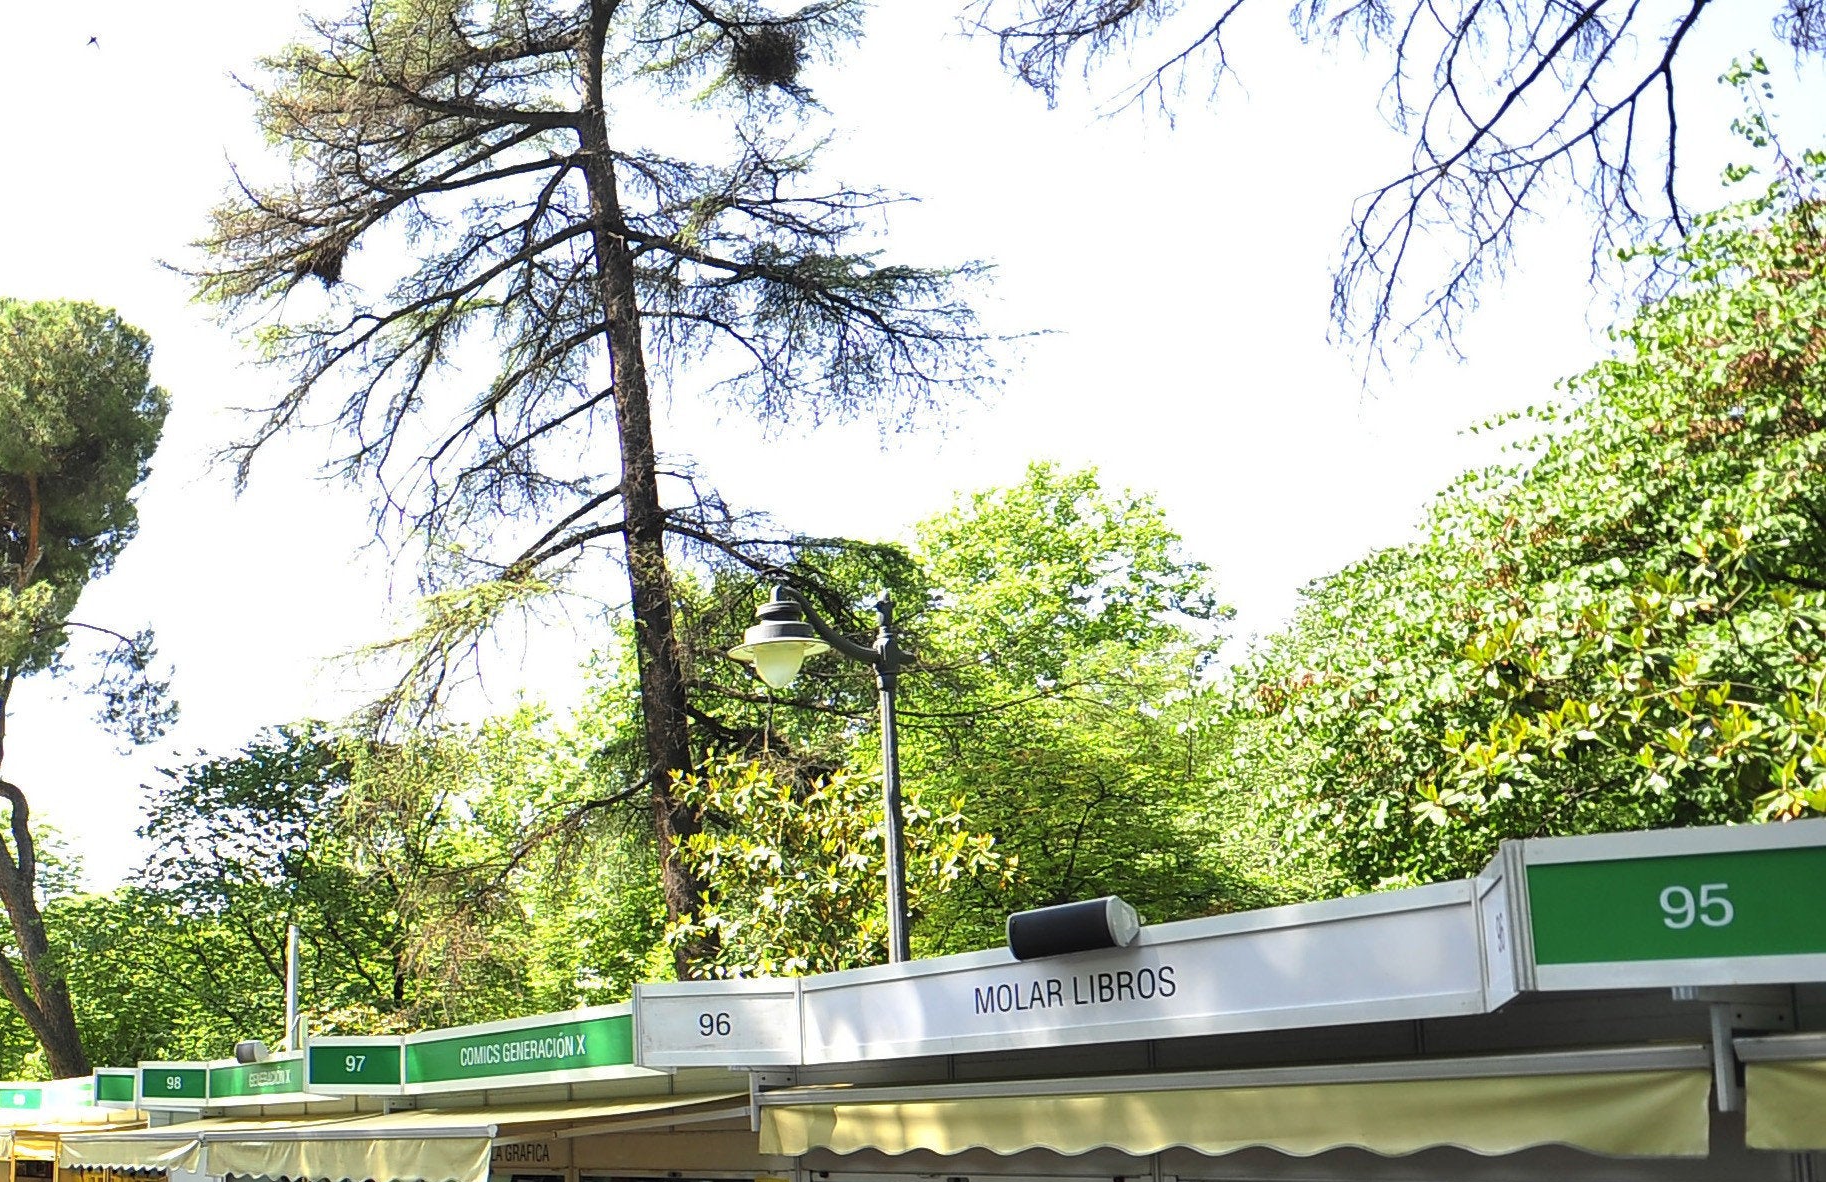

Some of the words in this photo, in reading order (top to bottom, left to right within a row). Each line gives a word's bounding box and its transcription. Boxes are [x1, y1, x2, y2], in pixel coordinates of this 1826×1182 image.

[1659, 882, 1734, 930] 95
[974, 978, 1064, 1015] MOLAR
[1073, 966, 1176, 1006] LIBROS
[699, 1012, 731, 1037] 96
[459, 1044, 501, 1067] COMICS
[502, 1031, 574, 1063] GENERACIÓN
[576, 1034, 586, 1055] X
[345, 1054, 366, 1072] 97
[166, 1076, 182, 1090] 98
[505, 1143, 550, 1163] GRAFICA
